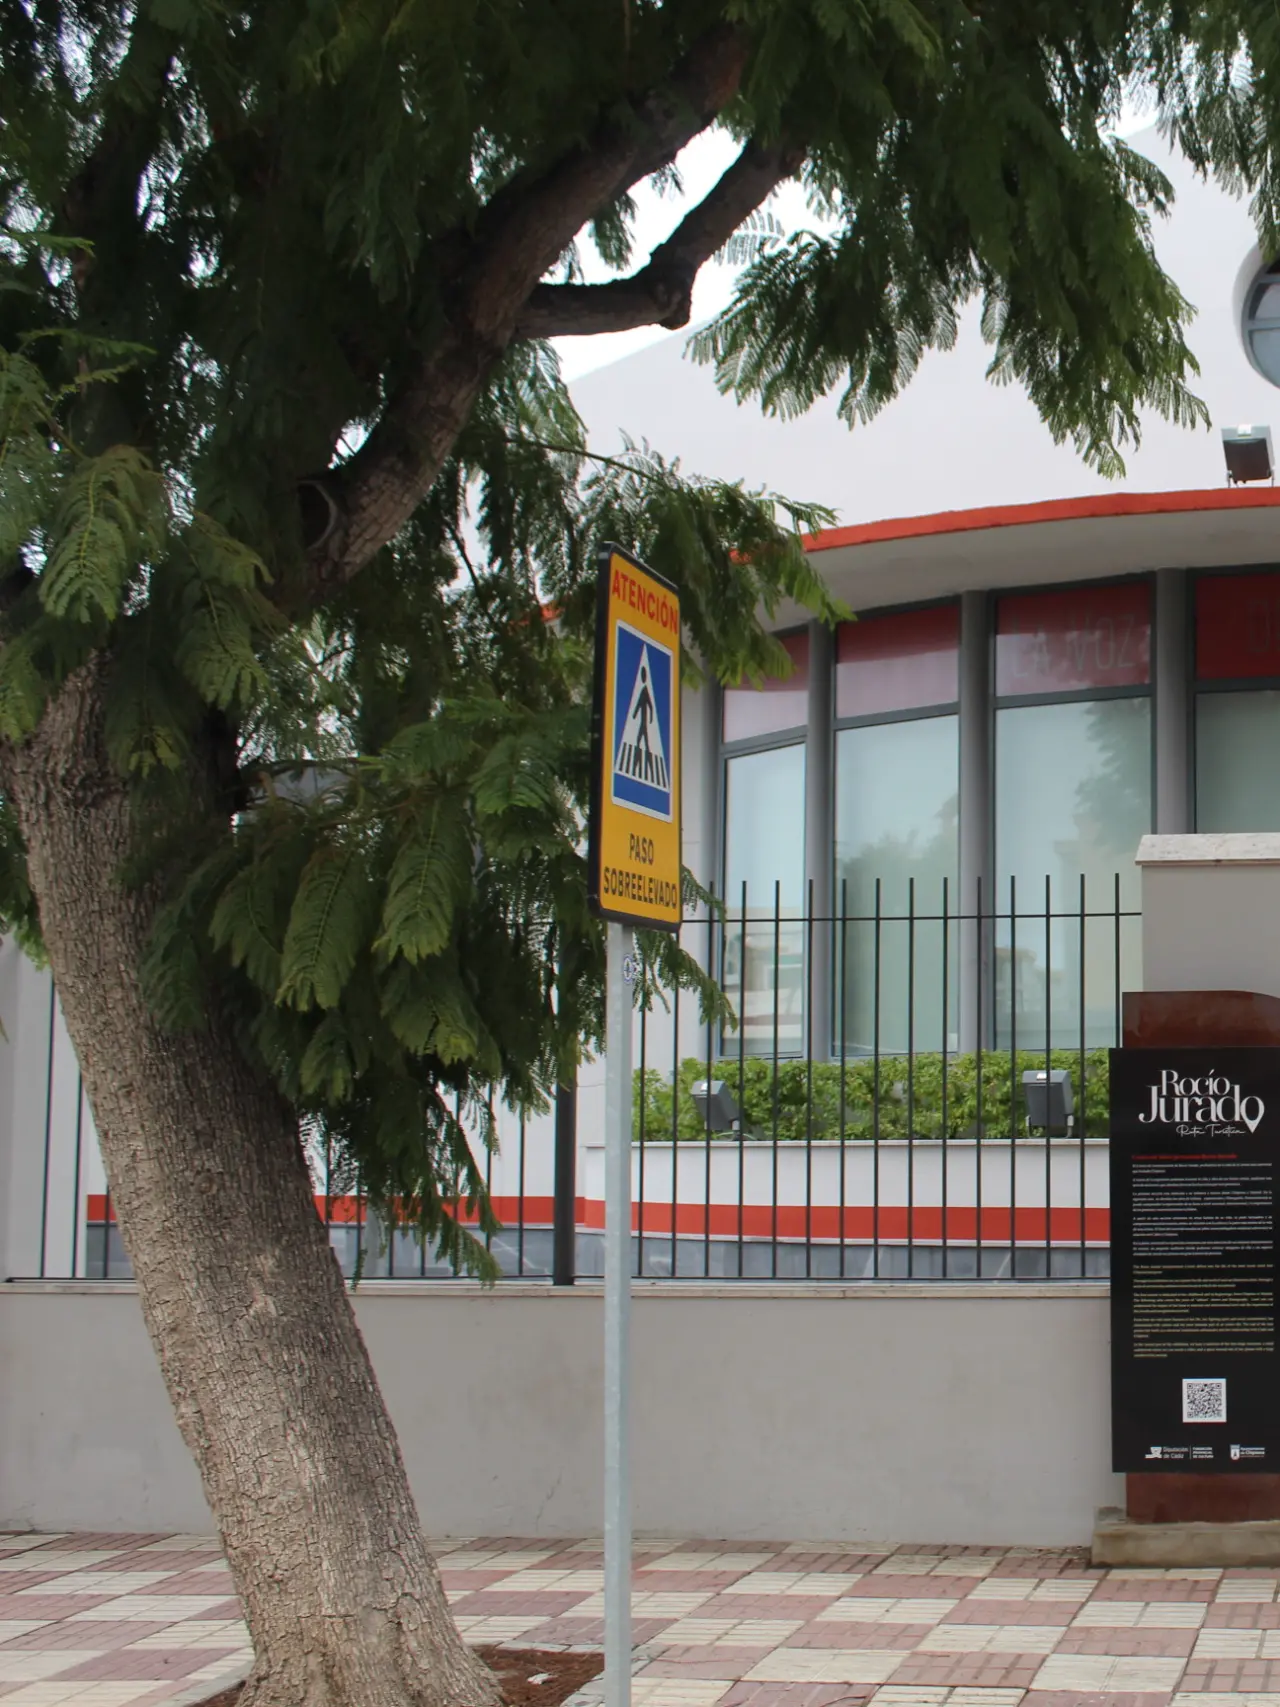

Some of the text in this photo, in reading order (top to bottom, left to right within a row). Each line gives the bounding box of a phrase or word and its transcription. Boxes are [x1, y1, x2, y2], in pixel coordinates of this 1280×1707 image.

[612, 569, 678, 635] ATENCIÓN
[629, 832, 655, 867] PASO
[603, 866, 678, 909] SOBREELEVADO
[1158, 1069, 1231, 1096] Rocío
[1138, 1084, 1265, 1134] Jurado
